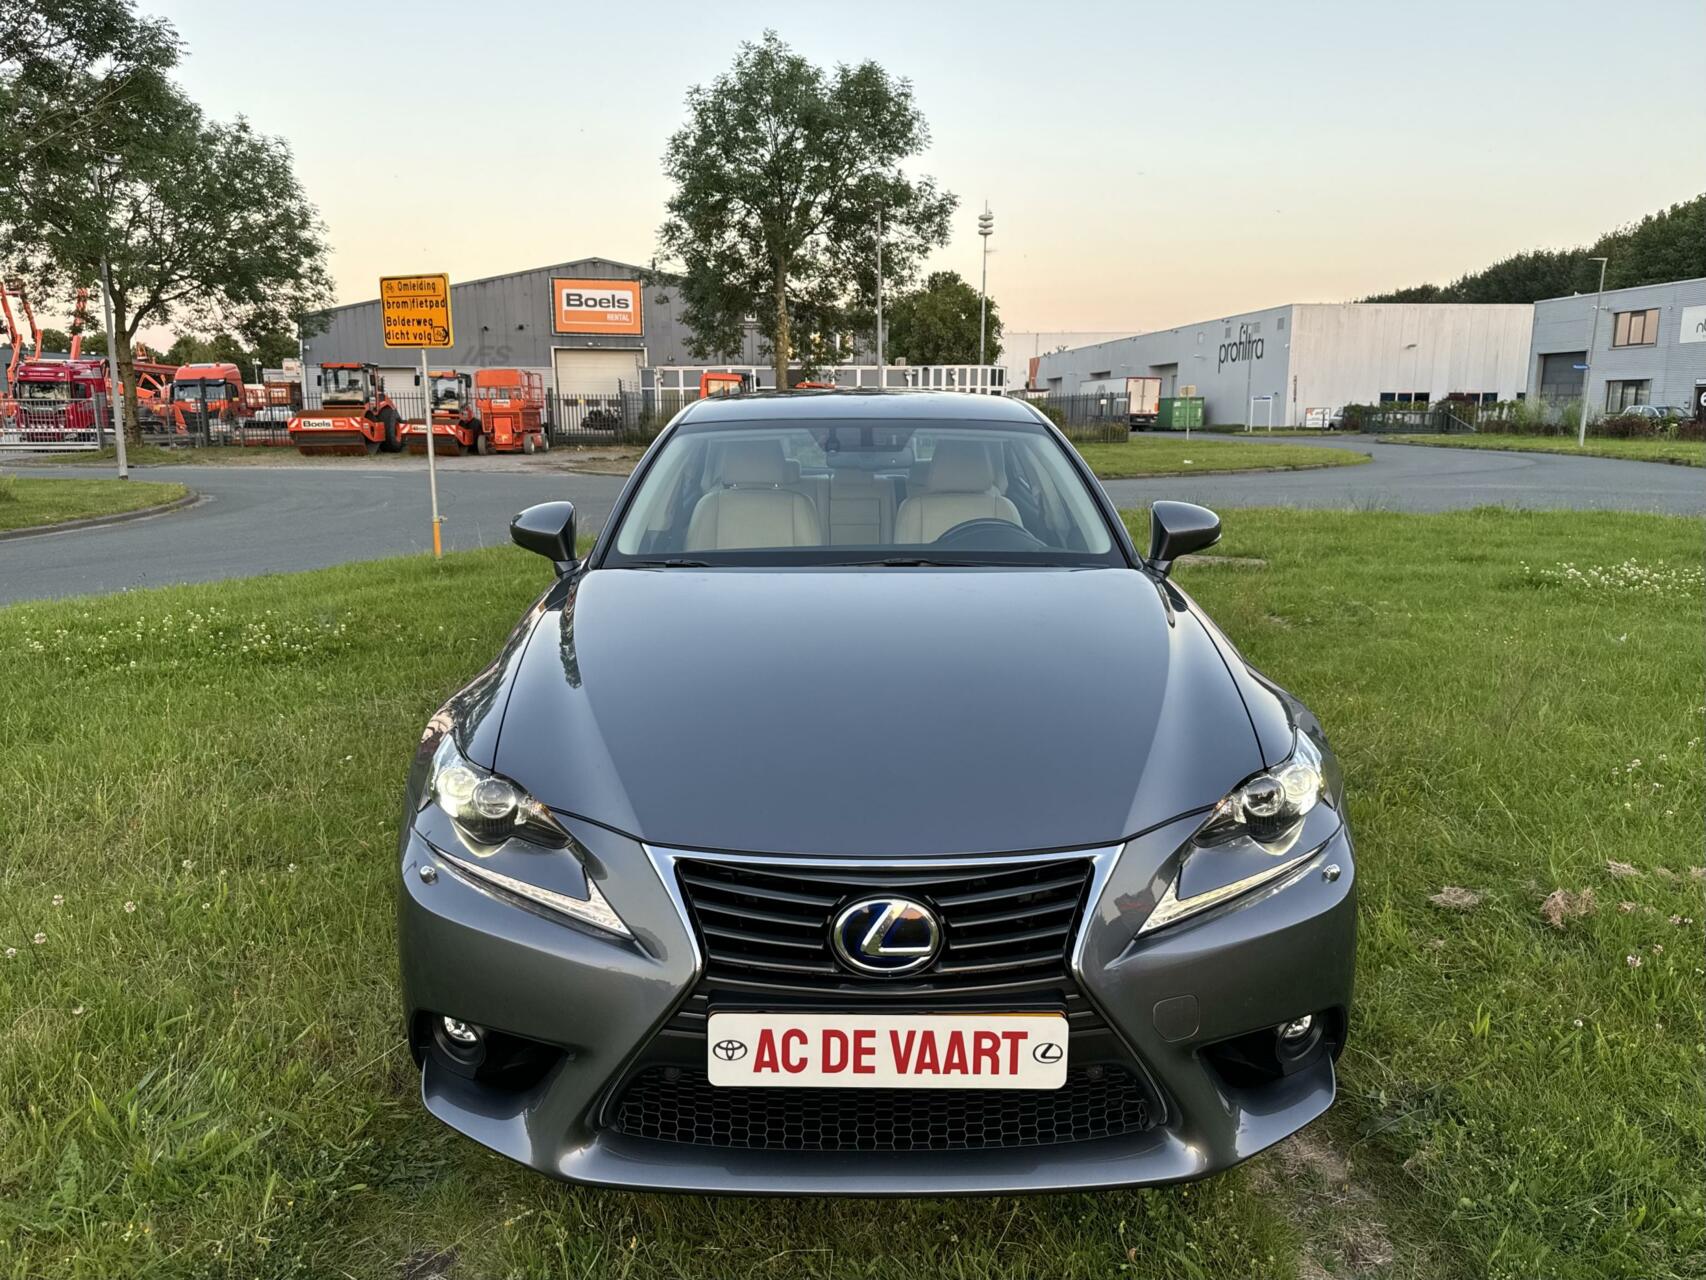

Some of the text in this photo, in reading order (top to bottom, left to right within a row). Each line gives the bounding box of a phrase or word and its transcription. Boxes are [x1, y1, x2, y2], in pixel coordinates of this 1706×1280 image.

[397, 281, 436, 293] Omleiding
[565, 292, 630, 309] Boels
[386, 316, 434, 329] Bolderweg
[606, 312, 631, 322] RENTAL
[386, 330, 432, 344] dicht volg
[1217, 324, 1265, 374] profiltra
[752, 1028, 1029, 1076] AC DE VAART
